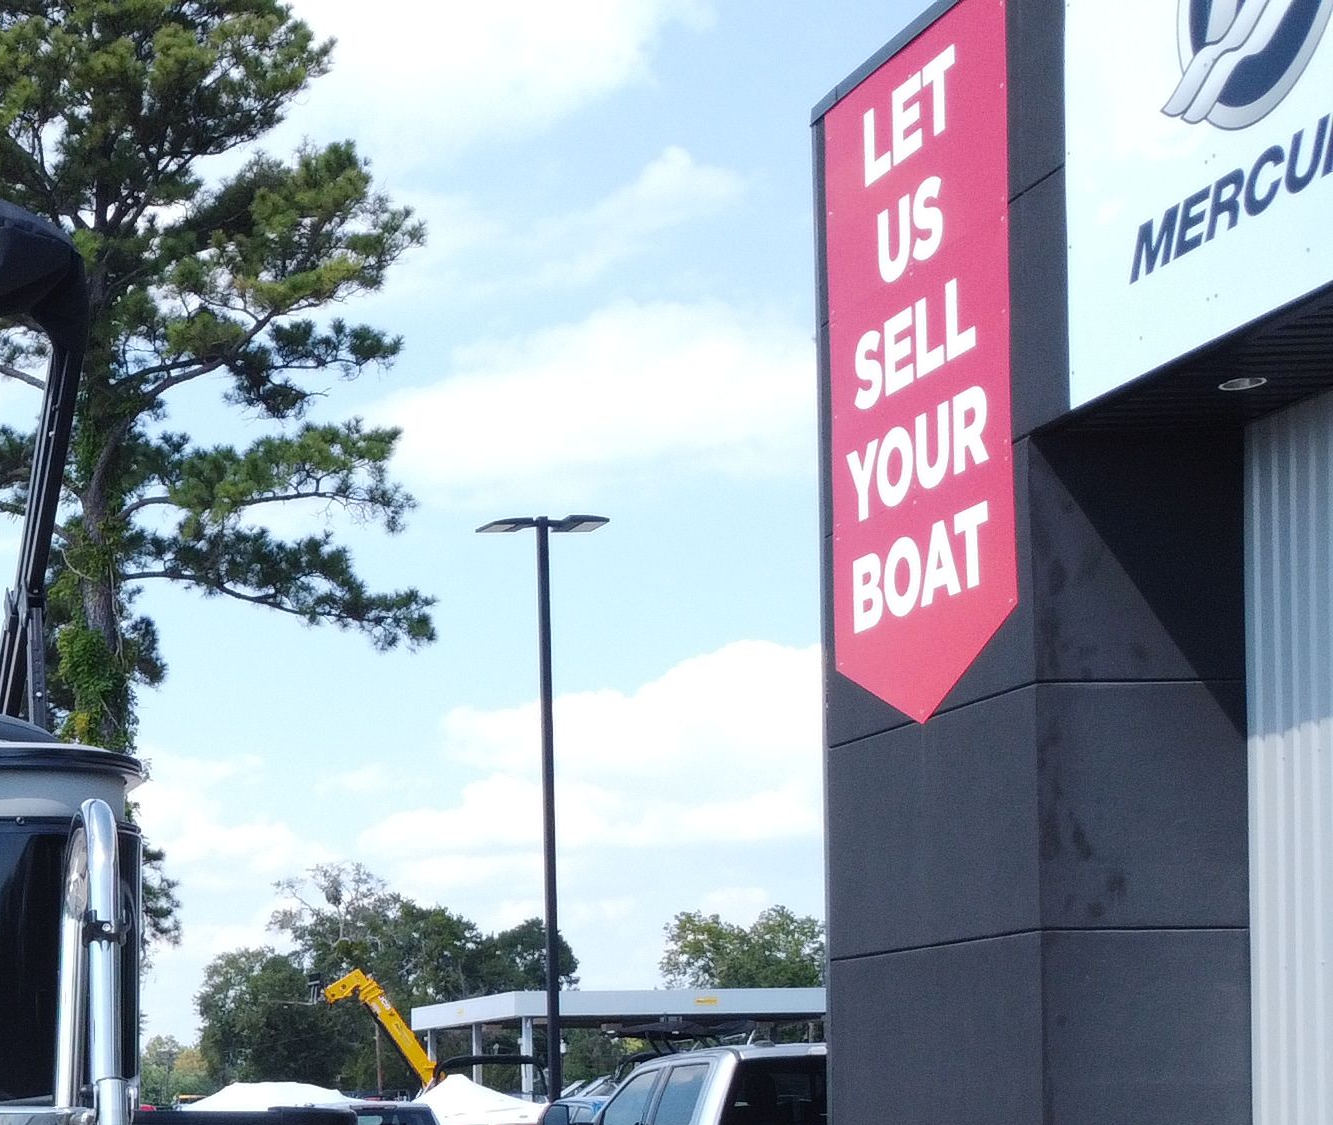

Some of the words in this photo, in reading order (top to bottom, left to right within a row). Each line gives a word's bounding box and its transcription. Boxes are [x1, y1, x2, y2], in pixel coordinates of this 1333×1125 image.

[863, 43, 956, 188] LET
[877, 176, 943, 283] US
[854, 277, 976, 411] SELL
[846, 385, 988, 522] YOUR
[853, 501, 989, 634] BOAT
